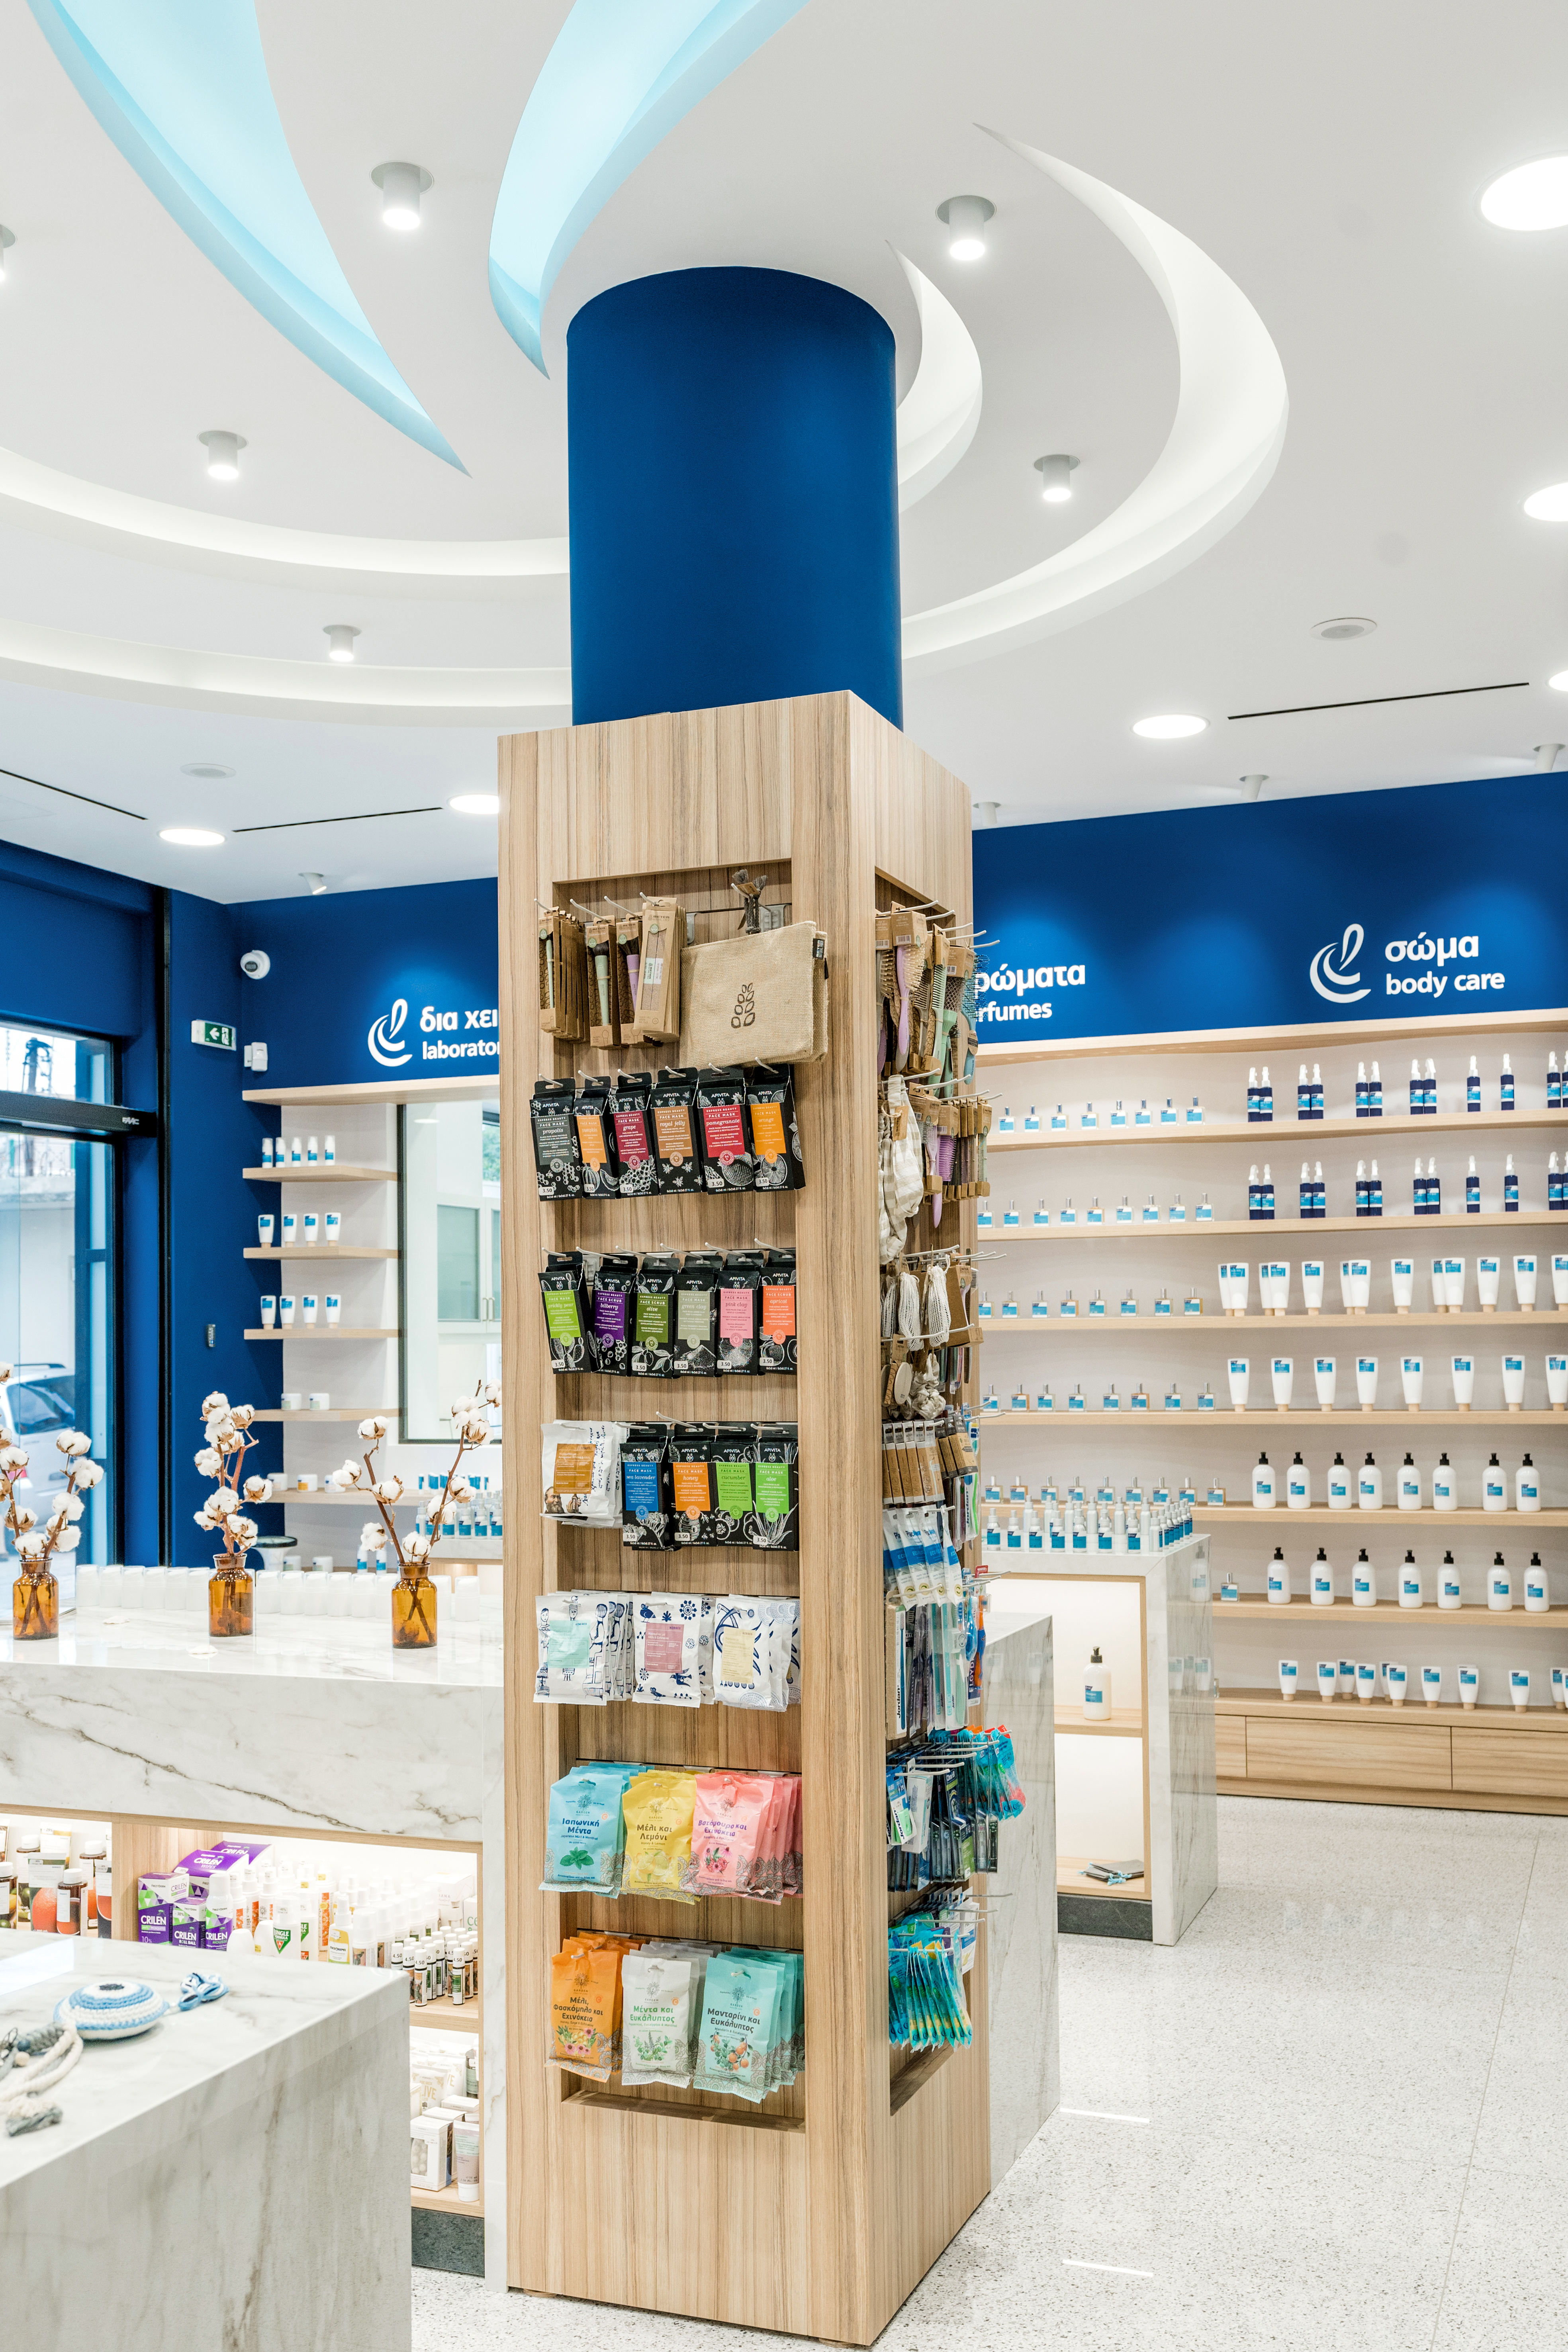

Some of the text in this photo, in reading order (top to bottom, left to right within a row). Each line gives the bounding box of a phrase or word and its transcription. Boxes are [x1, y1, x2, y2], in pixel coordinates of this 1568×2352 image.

[1385, 932, 1478, 967] σώμα
[1386, 971, 1505, 998] body care
[420, 1006, 498, 1032] δια χει
[562, 1818, 599, 1827] Ιαπωνική
[699, 1819, 734, 1829] Βατόμουρο
[894, 1810, 904, 1840] Jordan
[171, 1882, 187, 1892] CRILEN
[141, 1915, 166, 1925] CRILEN
[174, 1931, 196, 1941] CRILEN
[206, 1932, 227, 1940] CRILEN
[570, 1997, 589, 2005] Μέλι,
[554, 2004, 592, 2013] Φασκόμηλο
[562, 2013, 593, 2022] Εχινάκεια
[630, 2014, 675, 2023] Ευκάλυπτος
[707, 2008, 760, 2025] Μανταρίνι και
[710, 2017, 754, 2033] Ευκάλυπτος
